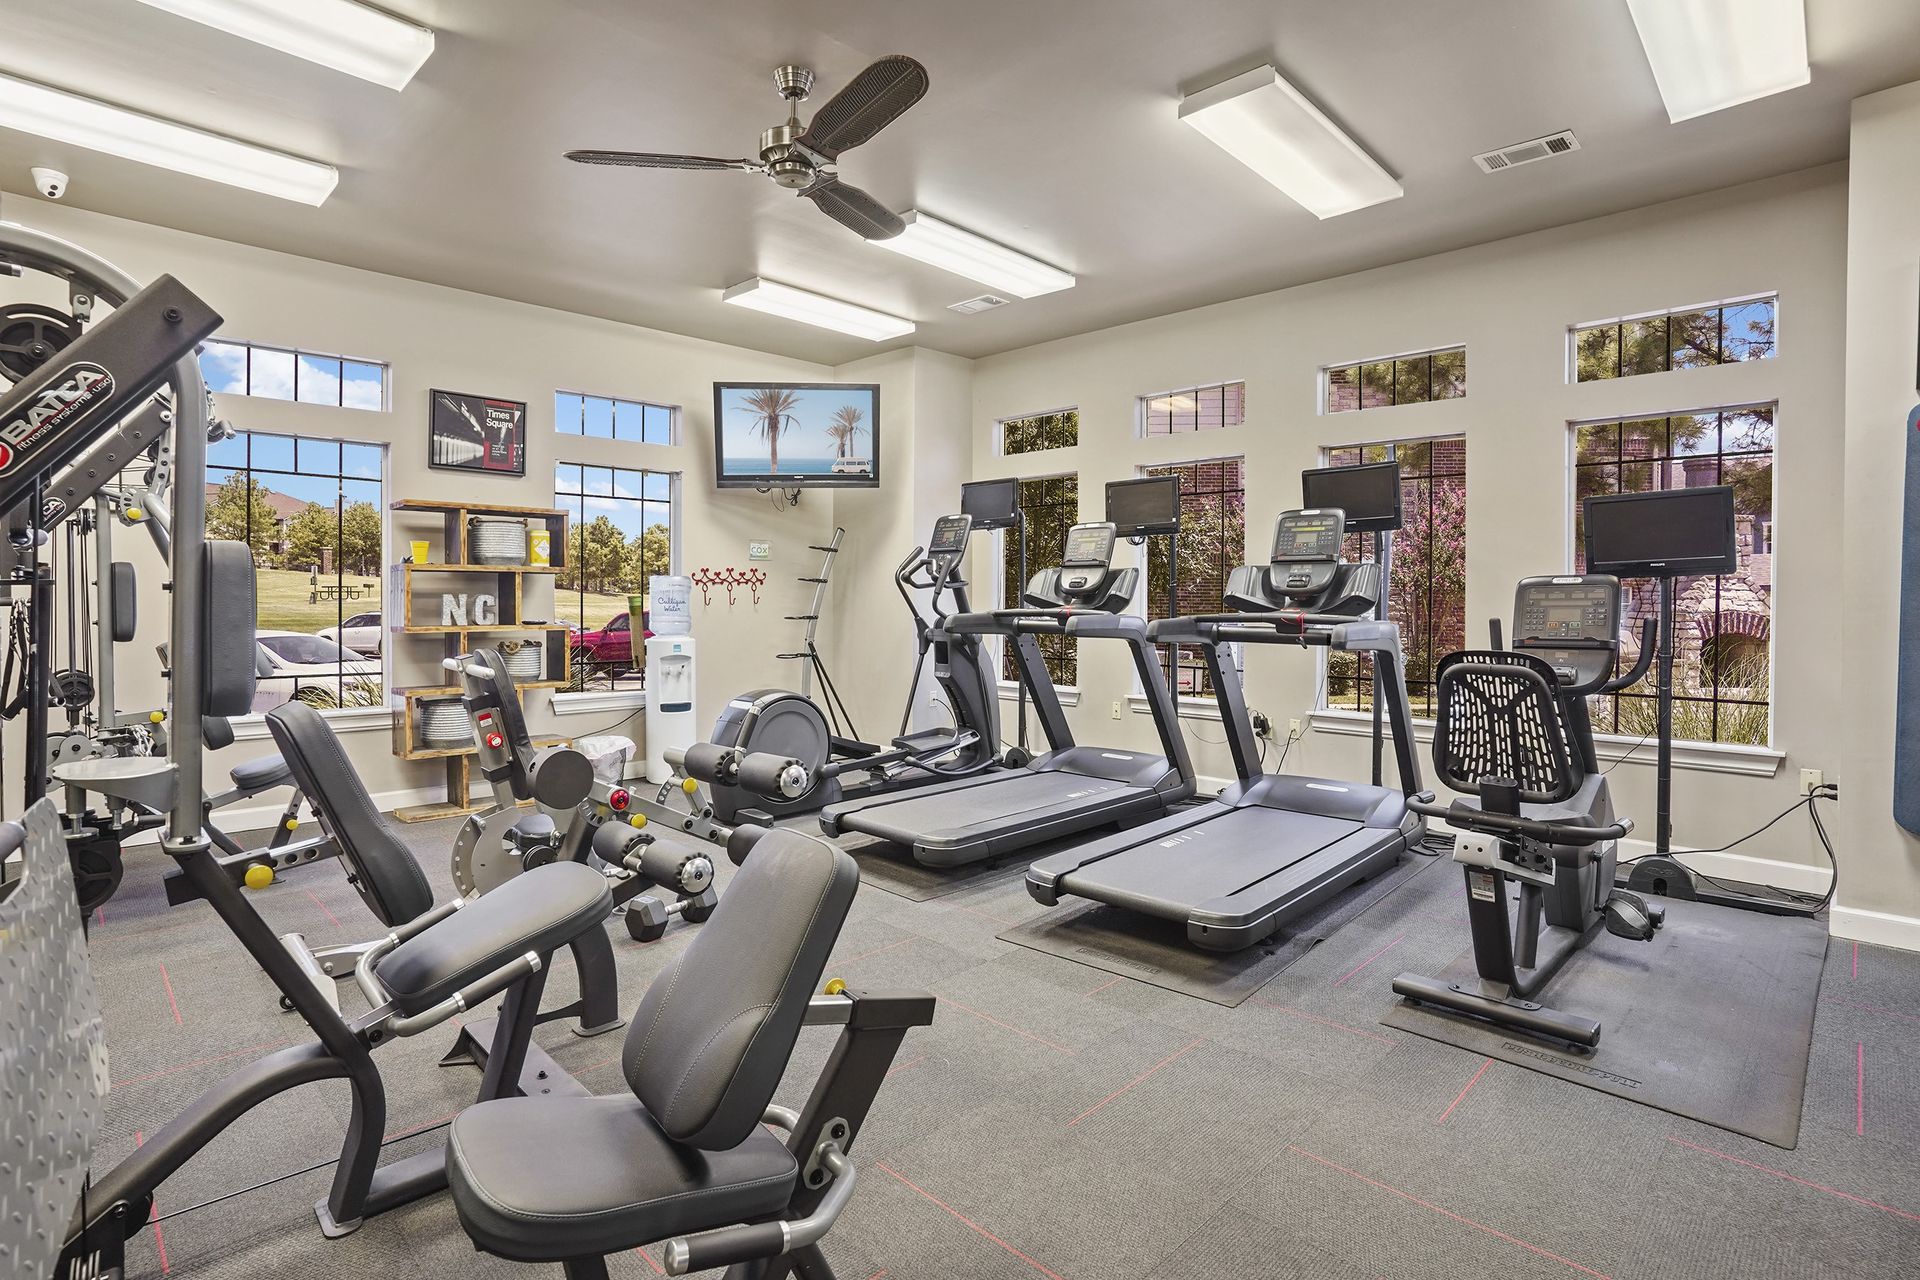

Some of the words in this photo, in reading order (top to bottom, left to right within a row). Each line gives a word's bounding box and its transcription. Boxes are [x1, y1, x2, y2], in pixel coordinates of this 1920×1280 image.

[0, 370, 105, 446] BATCA
[487, 409, 510, 420] Times
[486, 418, 513, 429] Square
[16, 423, 52, 451] fitness
[657, 596, 687, 607] Culligan
